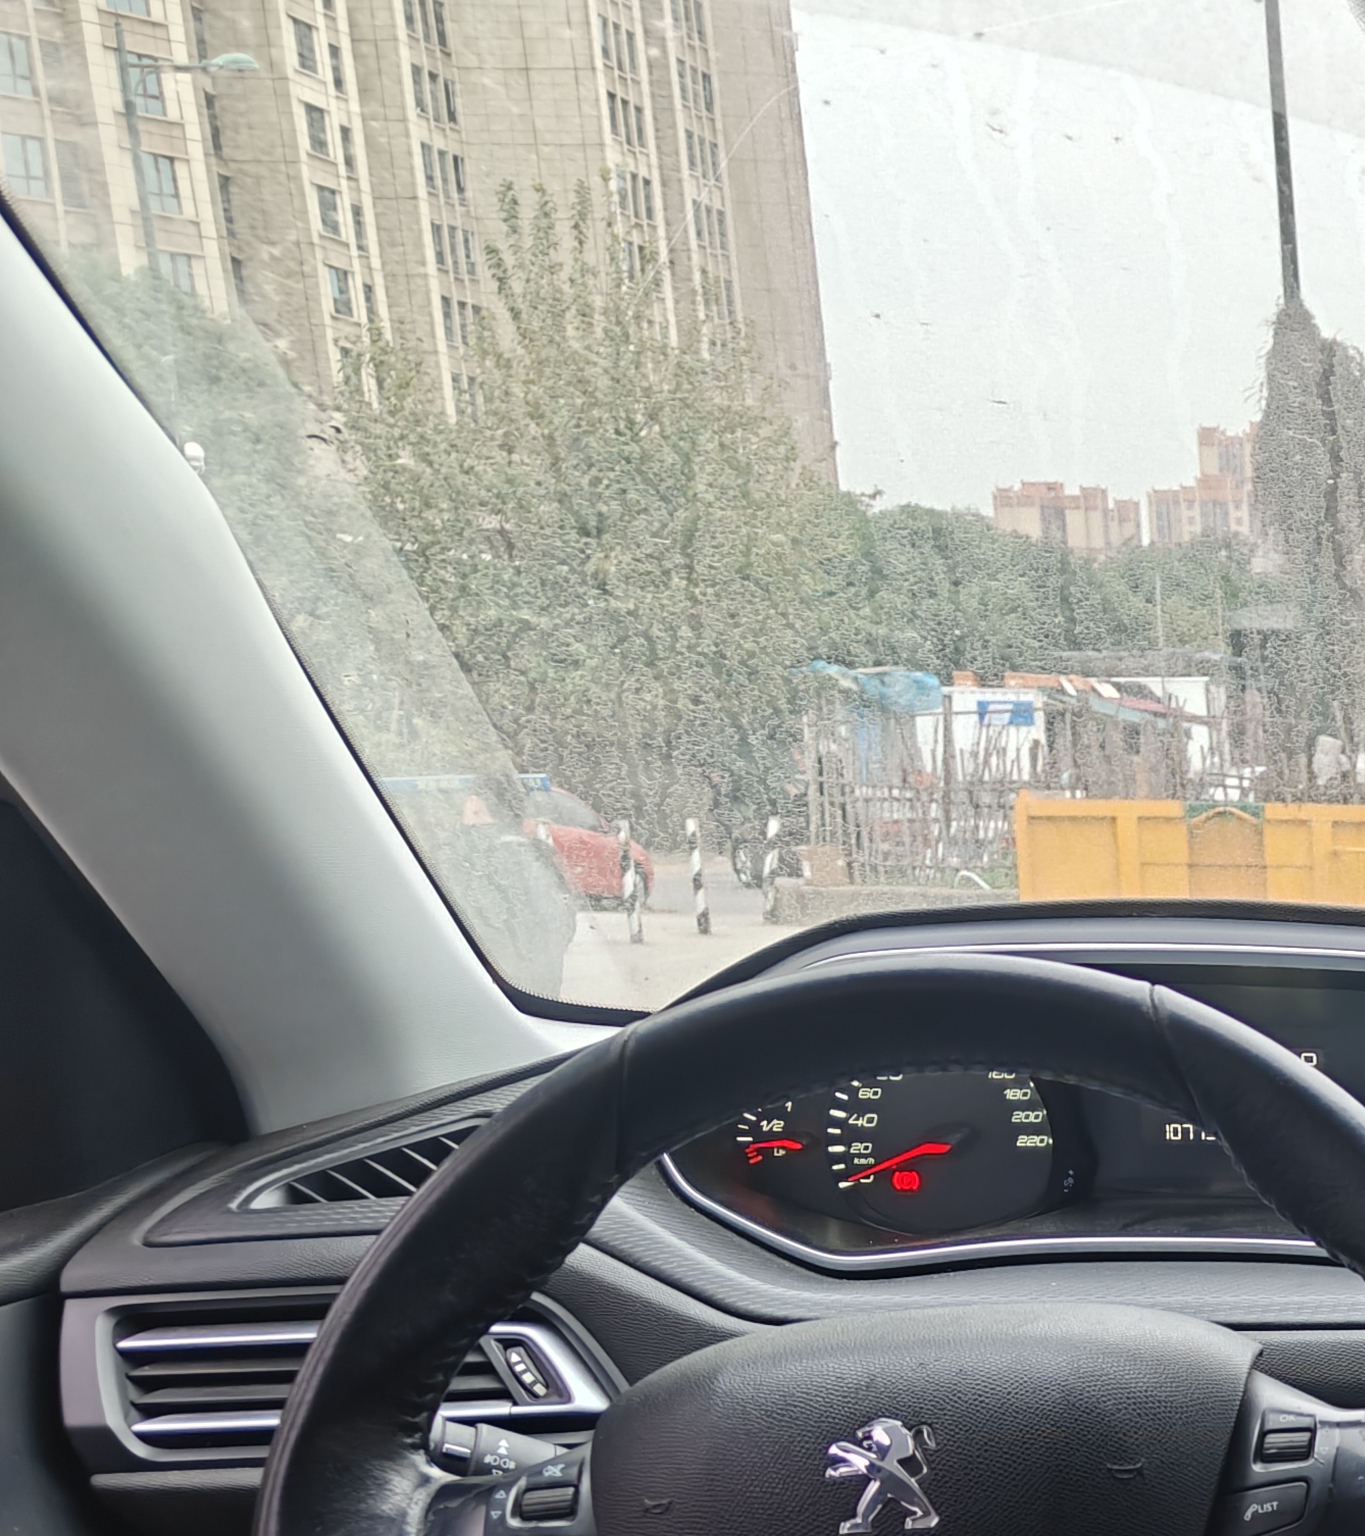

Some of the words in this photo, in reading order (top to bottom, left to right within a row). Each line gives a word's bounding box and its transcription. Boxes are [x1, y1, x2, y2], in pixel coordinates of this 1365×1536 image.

[858, 1088, 882, 1099] 60
[1003, 1088, 1031, 1100] 180
[848, 1113, 878, 1127] 40
[1012, 1111, 1042, 1122] 200
[760, 1119, 785, 1131] 1/2
[1016, 1135, 1047, 1146] 220
[850, 1143, 872, 1153] 20
[1258, 1501, 1279, 1513] LIST
